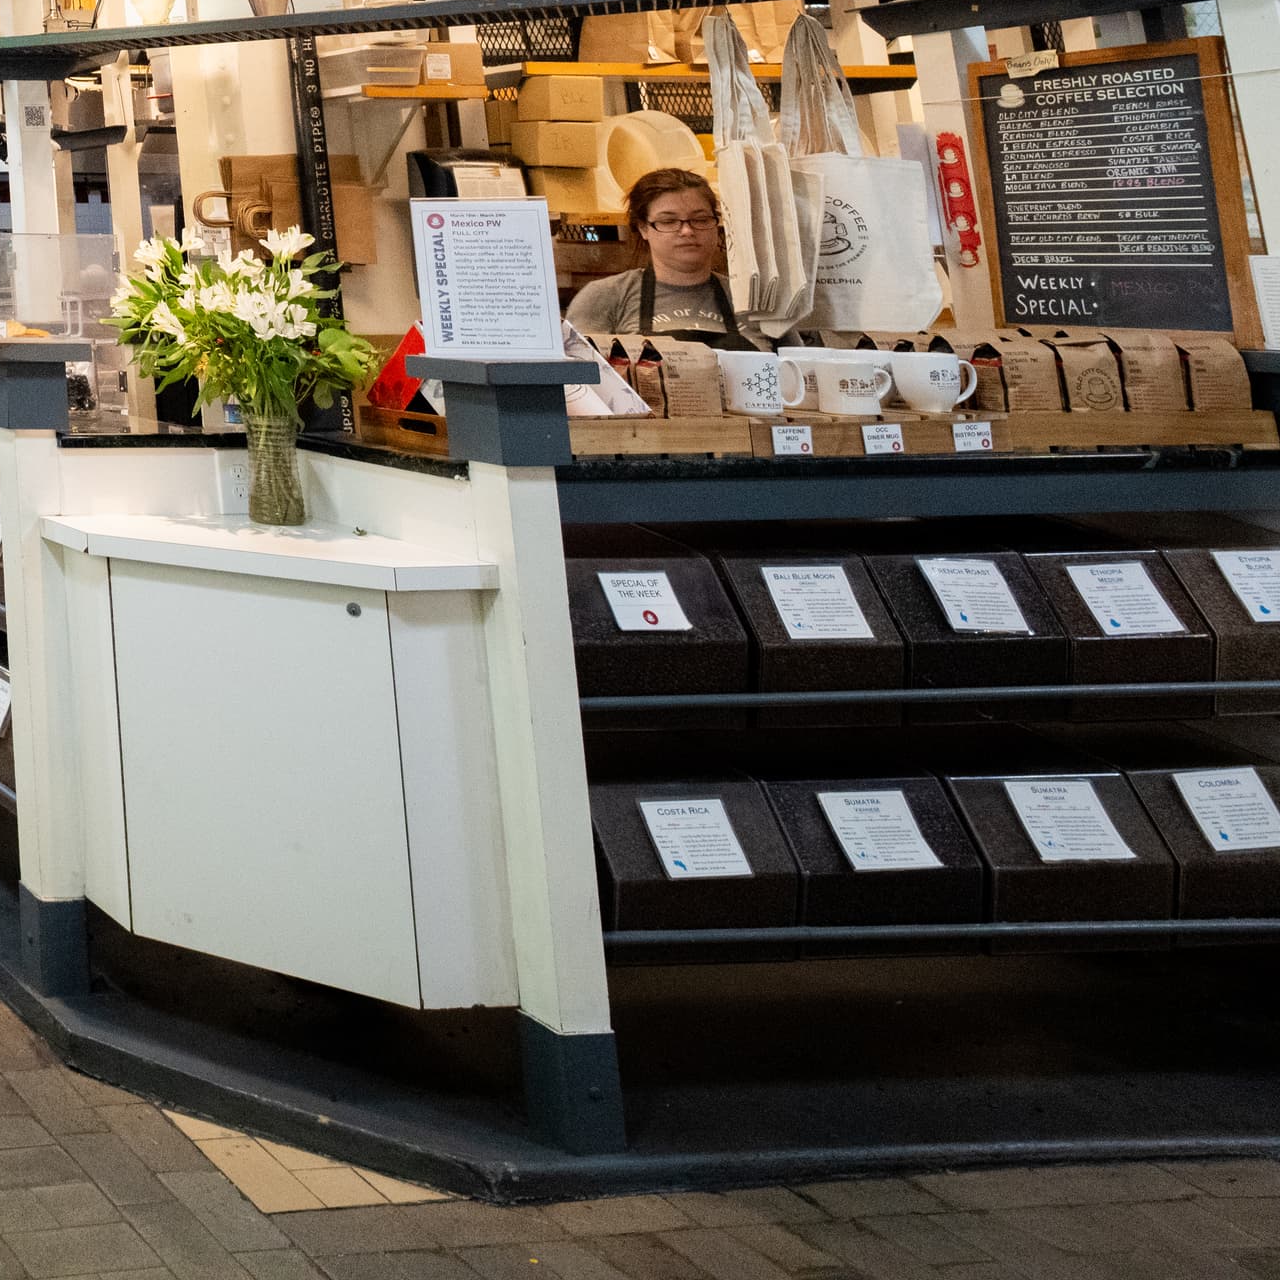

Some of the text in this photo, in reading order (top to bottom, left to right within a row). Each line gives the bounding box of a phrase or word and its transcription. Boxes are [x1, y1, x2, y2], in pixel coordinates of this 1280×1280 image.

[1034, 68, 1175, 92] FRESHLY ROASTED
[1036, 83, 1184, 106] COFFEE SELECTION
[1112, 102, 1149, 111] FRENCH
[1019, 111, 1037, 119] CITY
[1042, 107, 1078, 116] BLEND
[1126, 123, 1179, 132] COLOMBIA
[1048, 129, 1078, 137] BLEND
[1122, 132, 1191, 143] COSTA RICA
[305, 59, 333, 239] CHARLOTTE NO
[1005, 172, 1054, 181] LA BLEND
[1107, 165, 1177, 178] ORGANIC JAVA
[432, 232, 454, 343] WEEKLY SPECIAL
[1018, 275, 1084, 290] WEEKLY
[1016, 294, 1093, 316] SPECIAL
[813, 572, 836, 580] MOON
[611, 579, 659, 589] SPECIAL OF
[618, 589, 662, 599] THE WEEK
[1198, 779, 1241, 788] COLOMBIA
[1031, 786, 1068, 794] SUMATRA
[844, 798, 880, 806] SUMATRA
[657, 807, 710, 816] COSTA RICA
